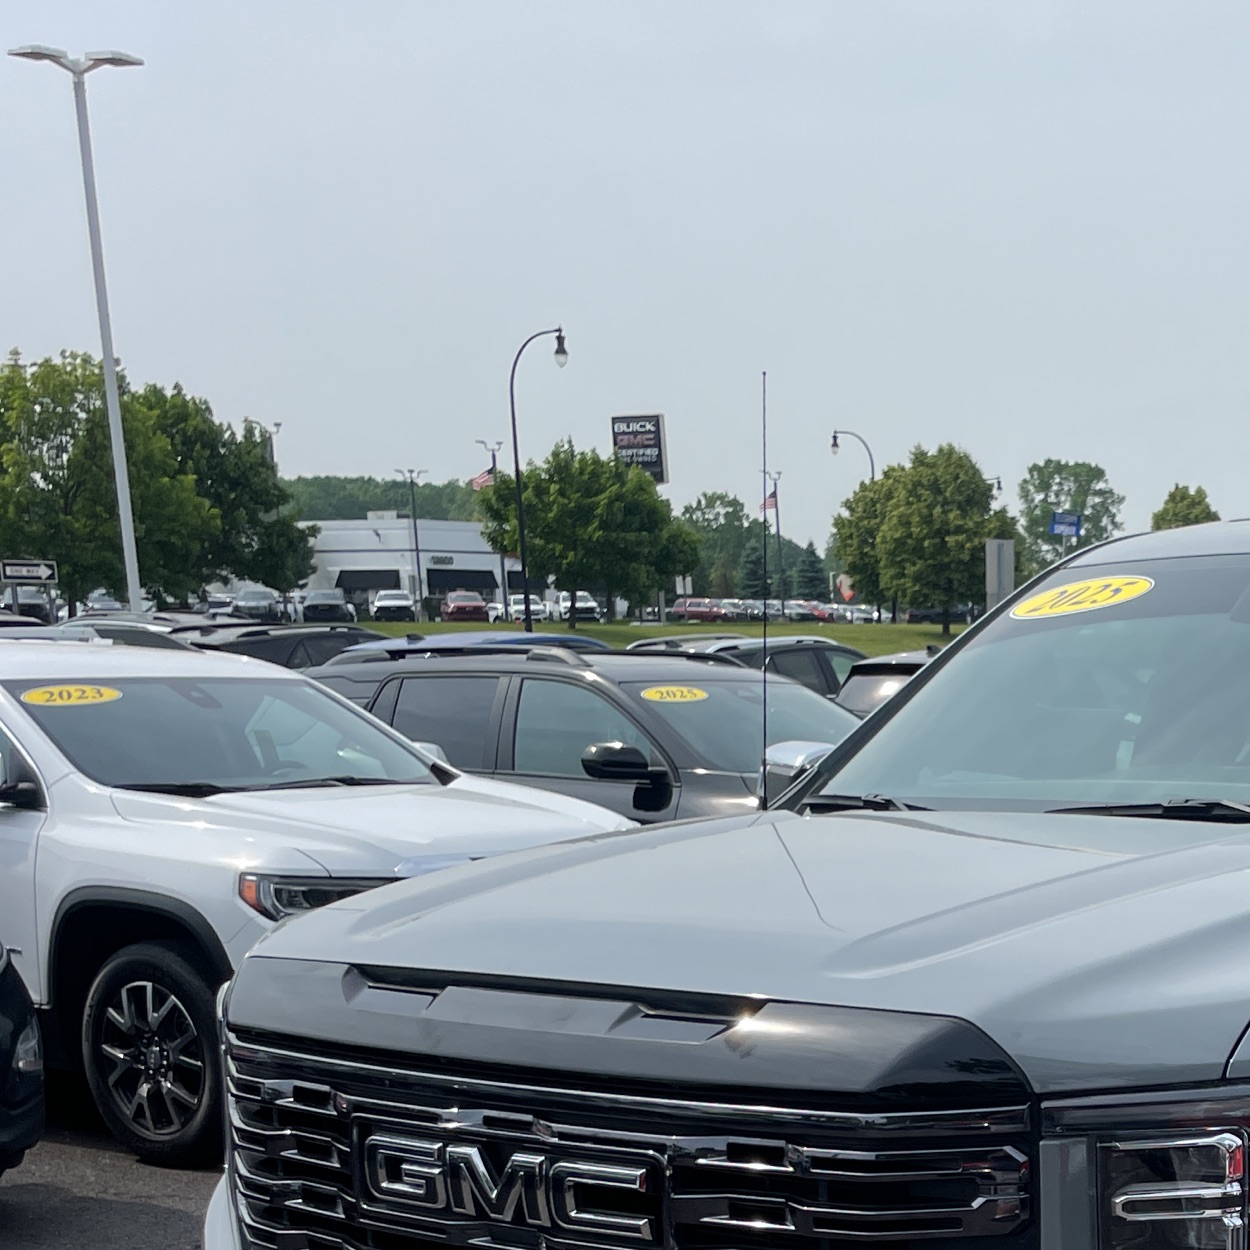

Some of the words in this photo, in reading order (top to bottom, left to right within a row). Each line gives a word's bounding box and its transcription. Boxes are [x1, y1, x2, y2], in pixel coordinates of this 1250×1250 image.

[614, 421, 657, 433] BUICK
[616, 433, 656, 447] GMC
[1023, 580, 1141, 615] 2025
[42, 687, 104, 703] 2023
[655, 684, 698, 700] 2025
[364, 1133, 653, 1241] GMC
